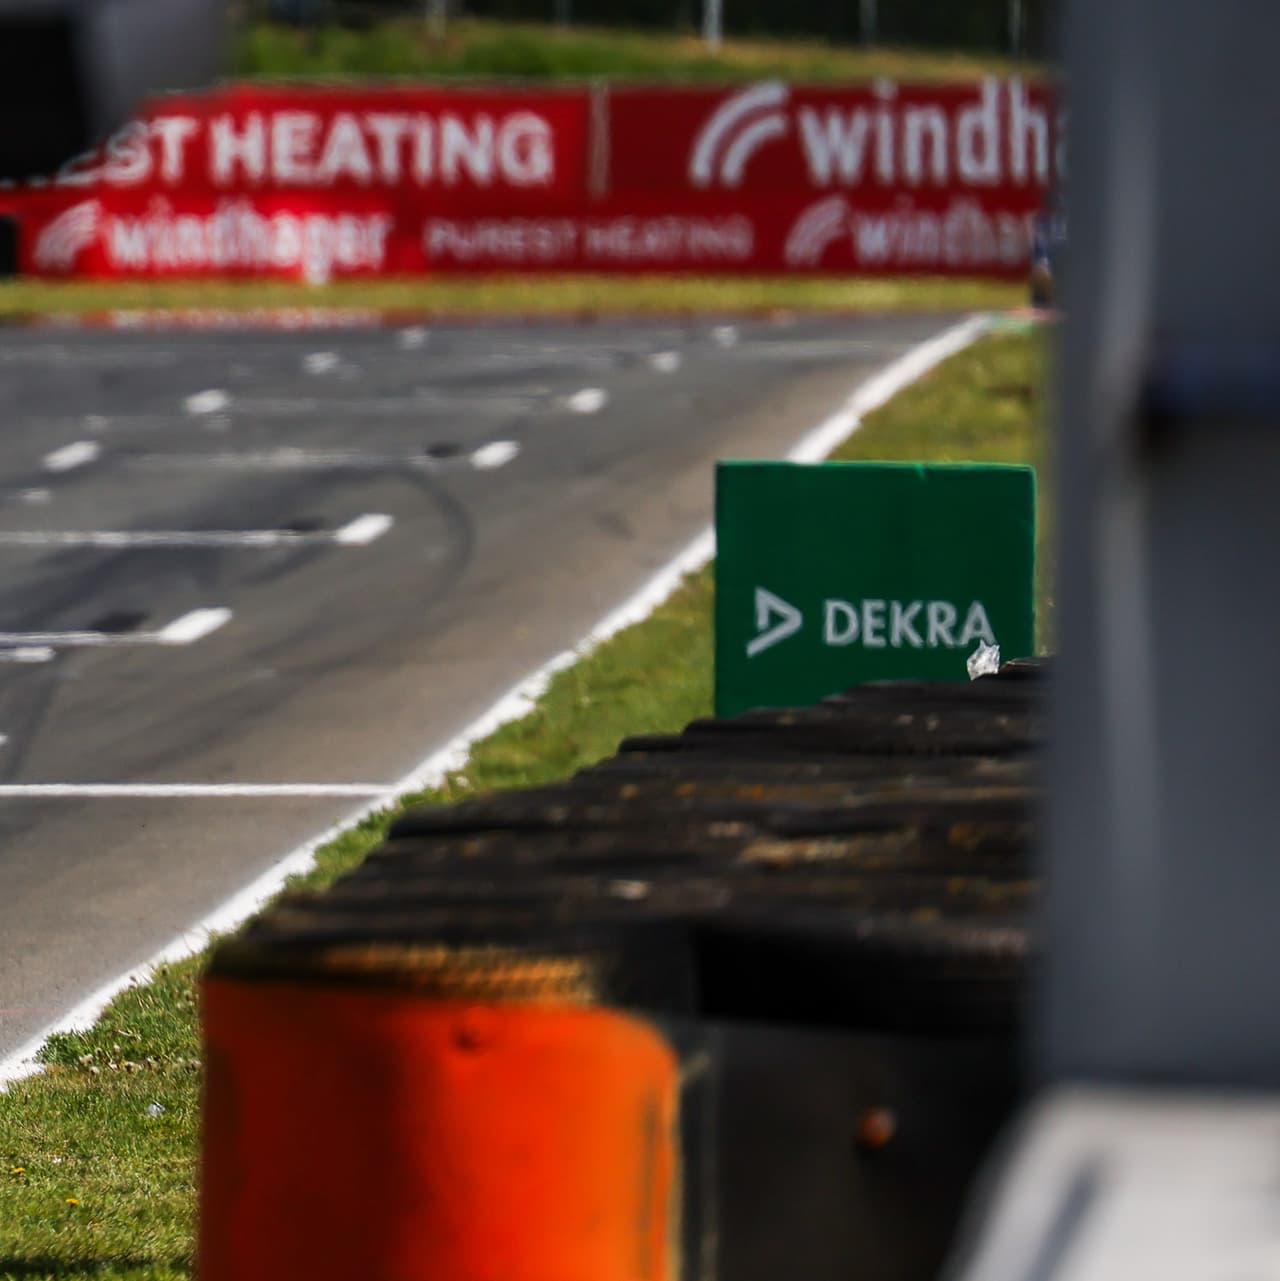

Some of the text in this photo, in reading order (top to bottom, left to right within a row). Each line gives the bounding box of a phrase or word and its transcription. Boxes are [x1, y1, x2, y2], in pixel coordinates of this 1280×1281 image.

[210, 110, 554, 186] HEATING
[798, 76, 1050, 186] windh
[106, 194, 390, 286] windhager
[822, 598, 997, 648] DEKRA
